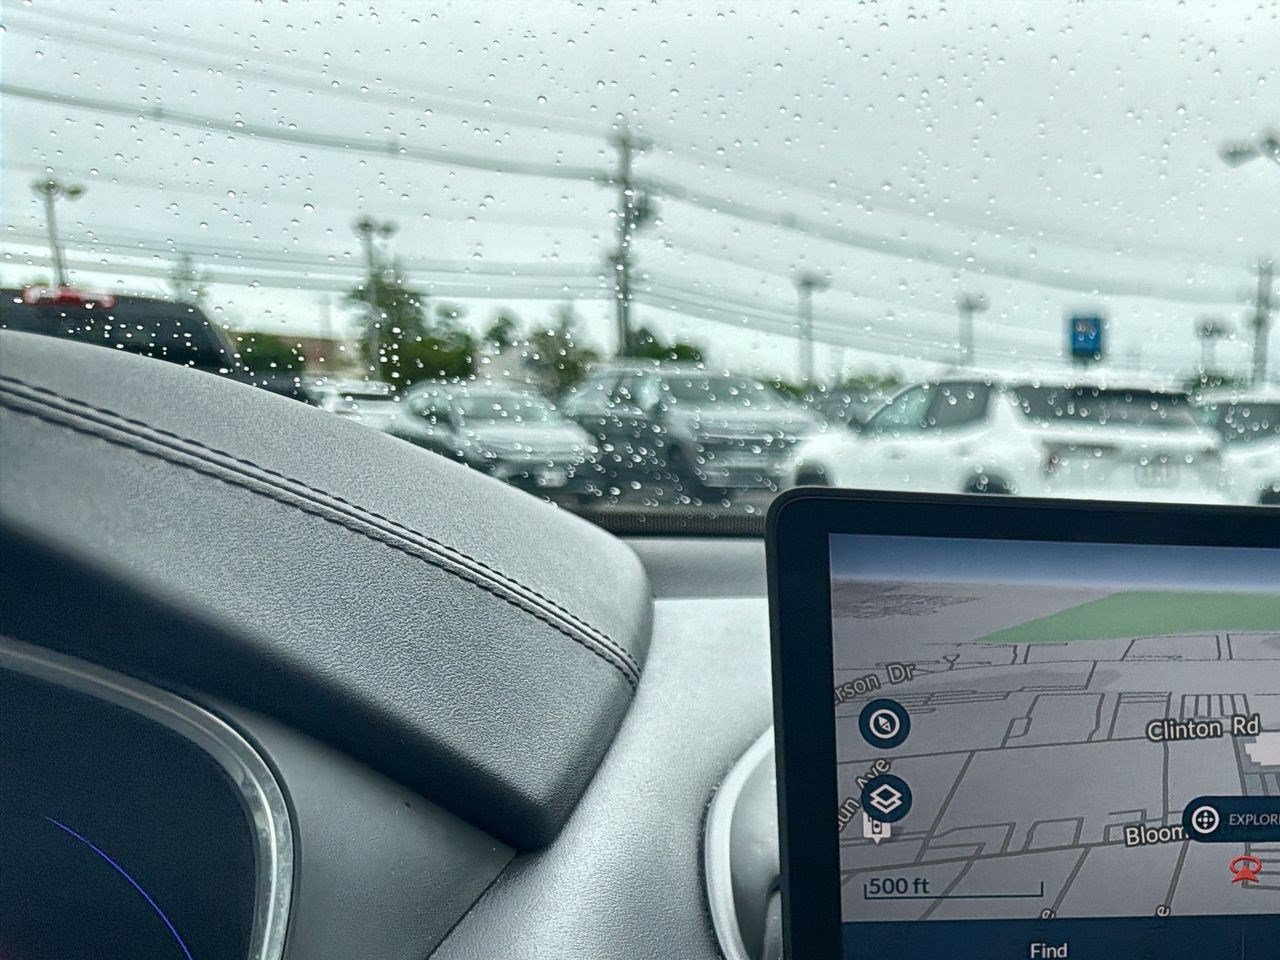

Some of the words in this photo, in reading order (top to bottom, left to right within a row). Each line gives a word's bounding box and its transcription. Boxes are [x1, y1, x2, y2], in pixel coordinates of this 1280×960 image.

[888, 663, 916, 684] Dr
[1147, 717, 1222, 741] Clinton
[1233, 715, 1260, 735] Rd
[869, 878, 908, 895] 500
[912, 878, 930, 895] ft
[1030, 943, 1068, 959] Find
